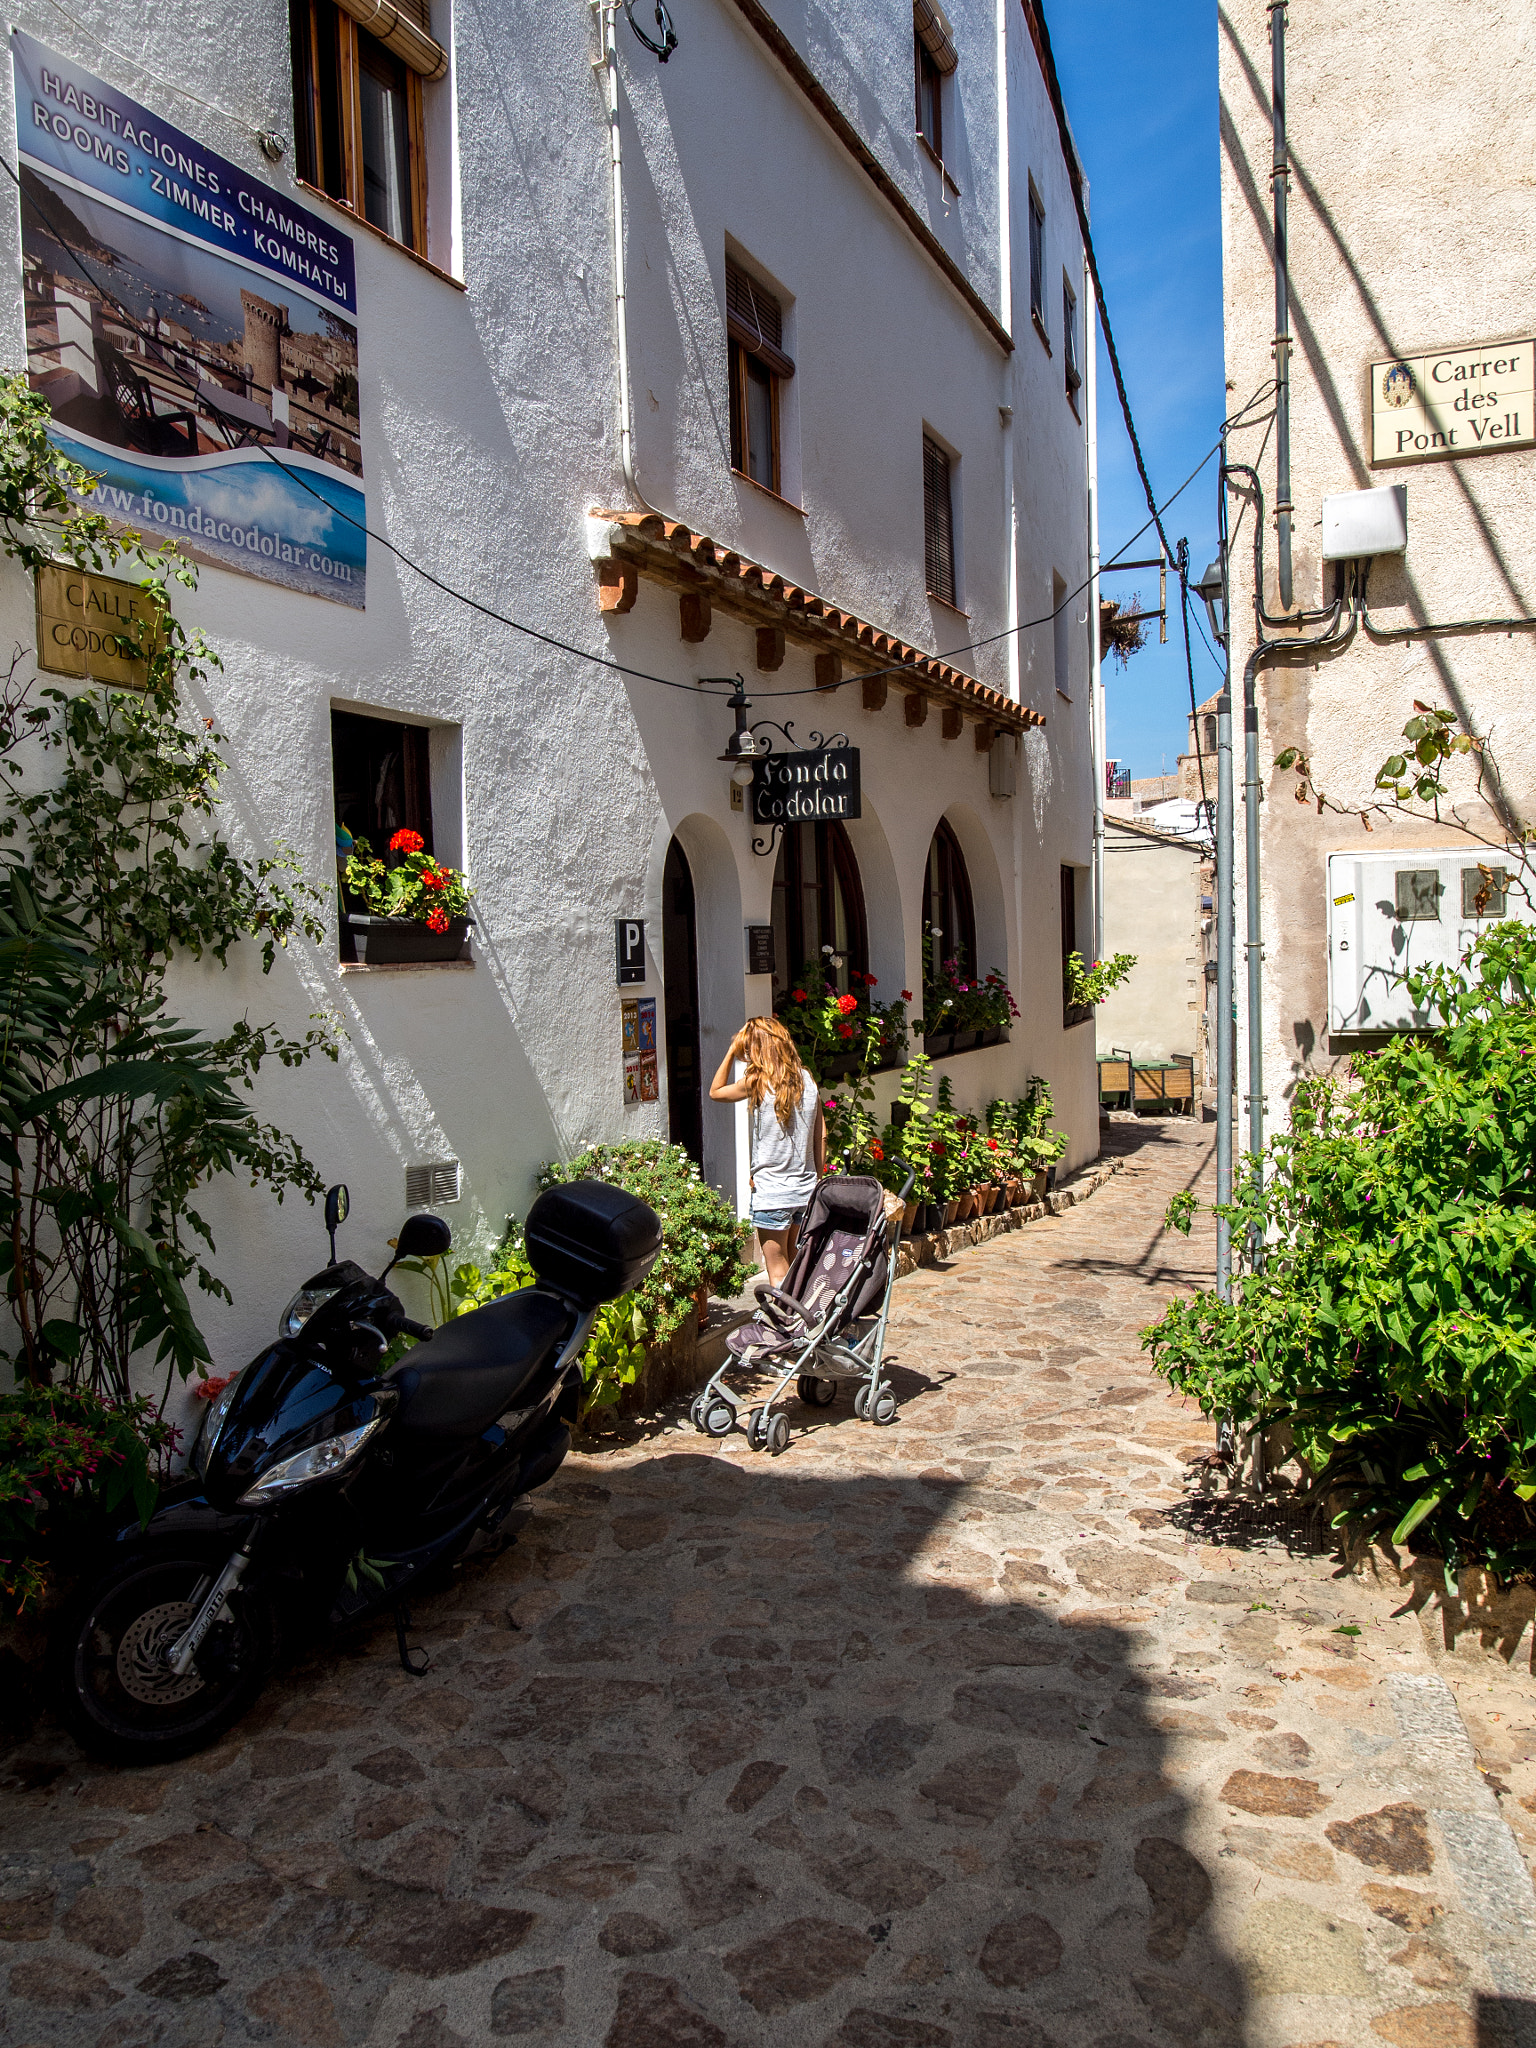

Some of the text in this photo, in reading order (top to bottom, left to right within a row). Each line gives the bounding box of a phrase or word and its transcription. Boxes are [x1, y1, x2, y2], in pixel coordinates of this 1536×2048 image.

[42, 70, 339, 266] HABITACIONES CHAMBRES
[33, 102, 348, 301] ROOMS ZIMMER КОМНАТЫ
[1431, 356, 1521, 384] Carrer
[1453, 388, 1499, 412] des
[1395, 412, 1522, 453] Pont Vell
[66, 584, 139, 620] CALLE
[53, 623, 157, 664] CODOLR
[760, 754, 848, 786] Fonda
[757, 787, 848, 818] Codolar
[626, 923, 640, 961] P
